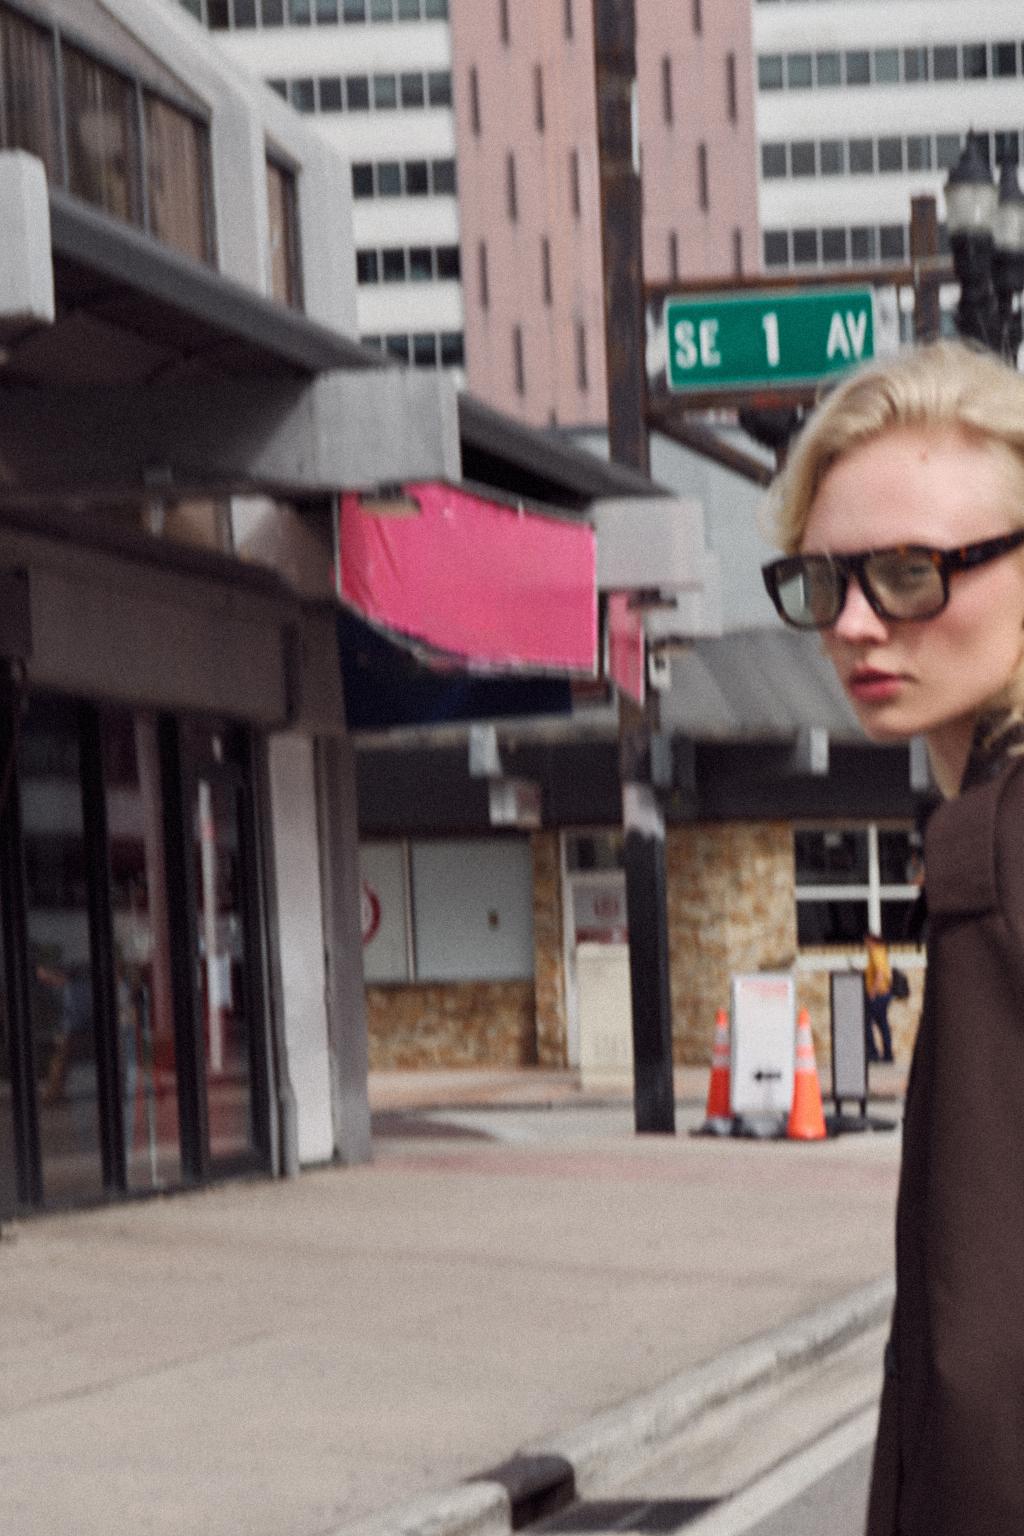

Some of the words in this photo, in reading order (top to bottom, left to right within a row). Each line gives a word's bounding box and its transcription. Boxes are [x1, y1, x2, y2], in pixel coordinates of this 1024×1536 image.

[674, 318, 721, 369] SE
[762, 311, 780, 367] 1
[826, 309, 867, 361] AV
